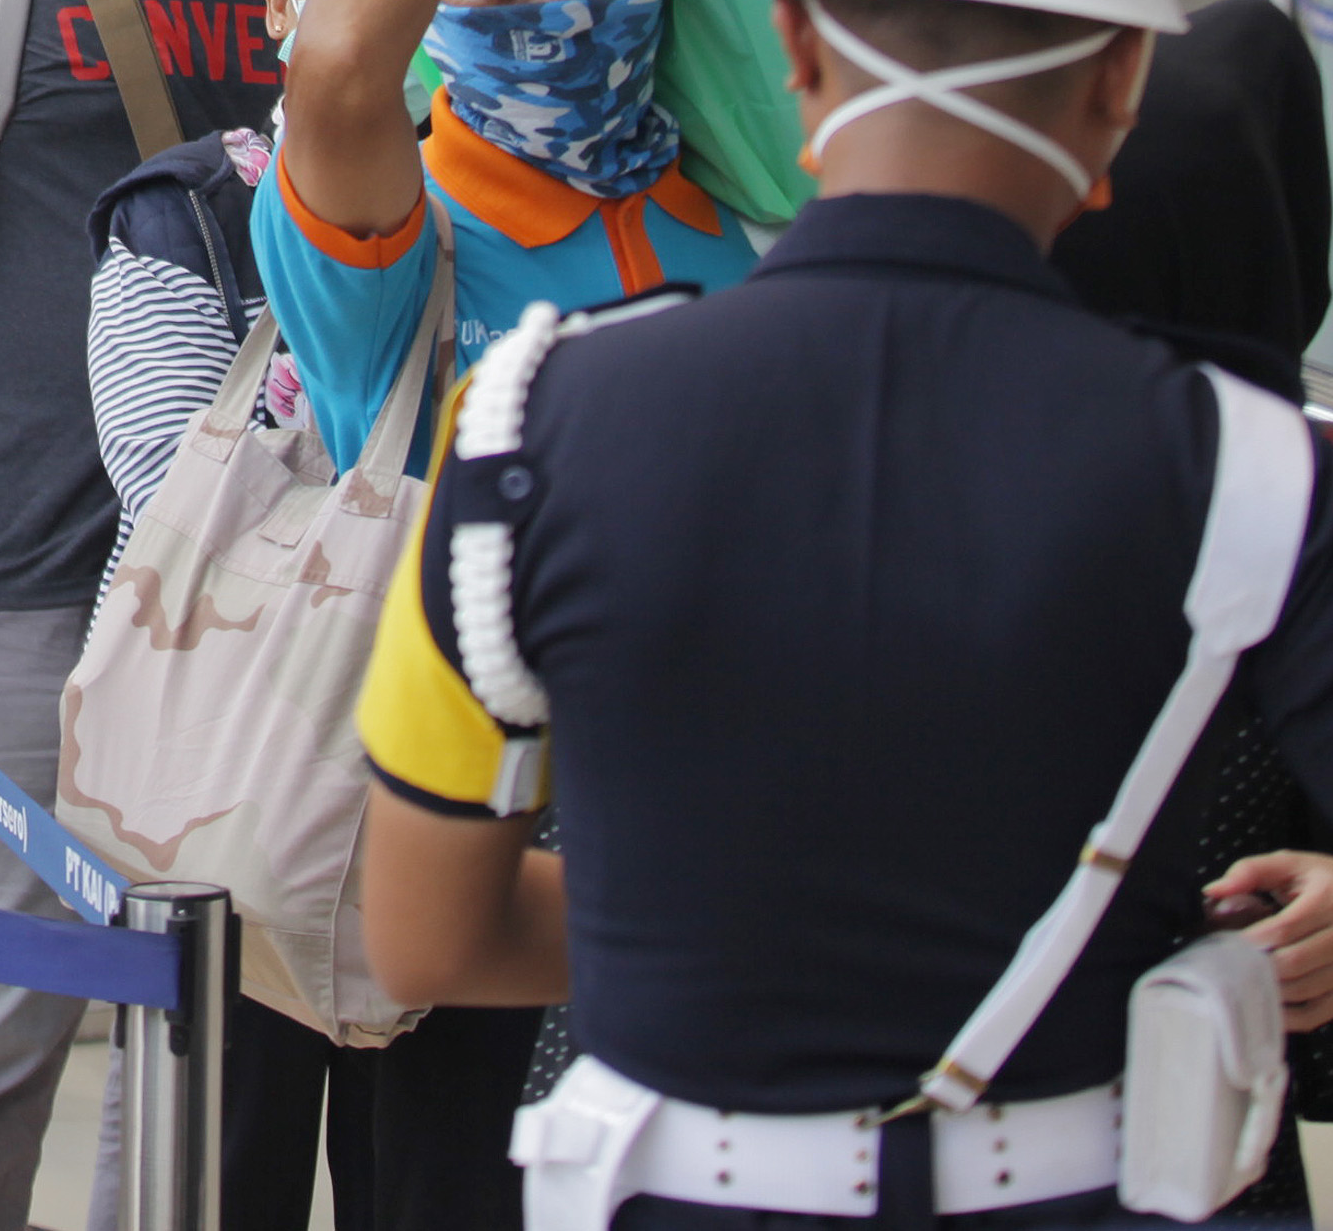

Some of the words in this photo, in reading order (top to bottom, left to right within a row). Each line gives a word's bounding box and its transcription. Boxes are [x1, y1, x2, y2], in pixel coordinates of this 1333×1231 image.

[56, 0, 287, 84] CNVE
[65, 845, 82, 893] PT
[82, 859, 103, 914] KAI
